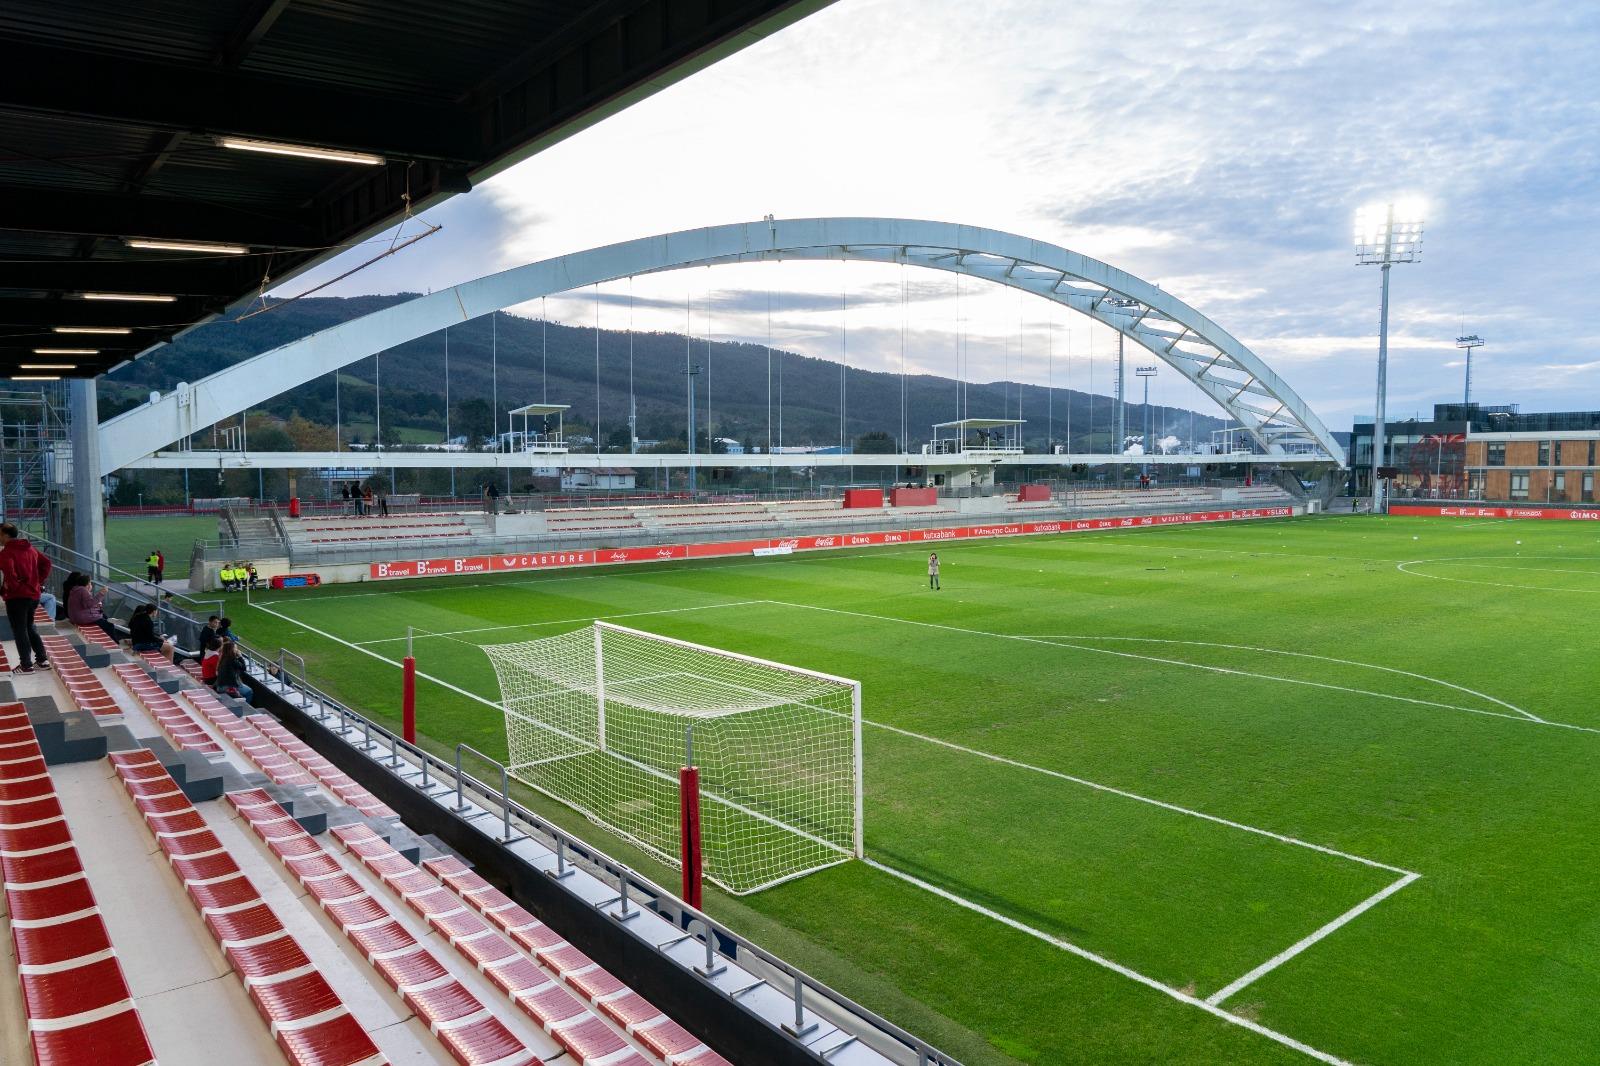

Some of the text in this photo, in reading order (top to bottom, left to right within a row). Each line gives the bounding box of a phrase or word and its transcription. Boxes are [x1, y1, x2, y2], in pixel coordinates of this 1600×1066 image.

[1578, 510, 1598, 519] IMQ
[1034, 524, 1060, 532] kutxabank
[924, 530, 956, 540] kutxabank
[521, 554, 584, 566] CASTORE
